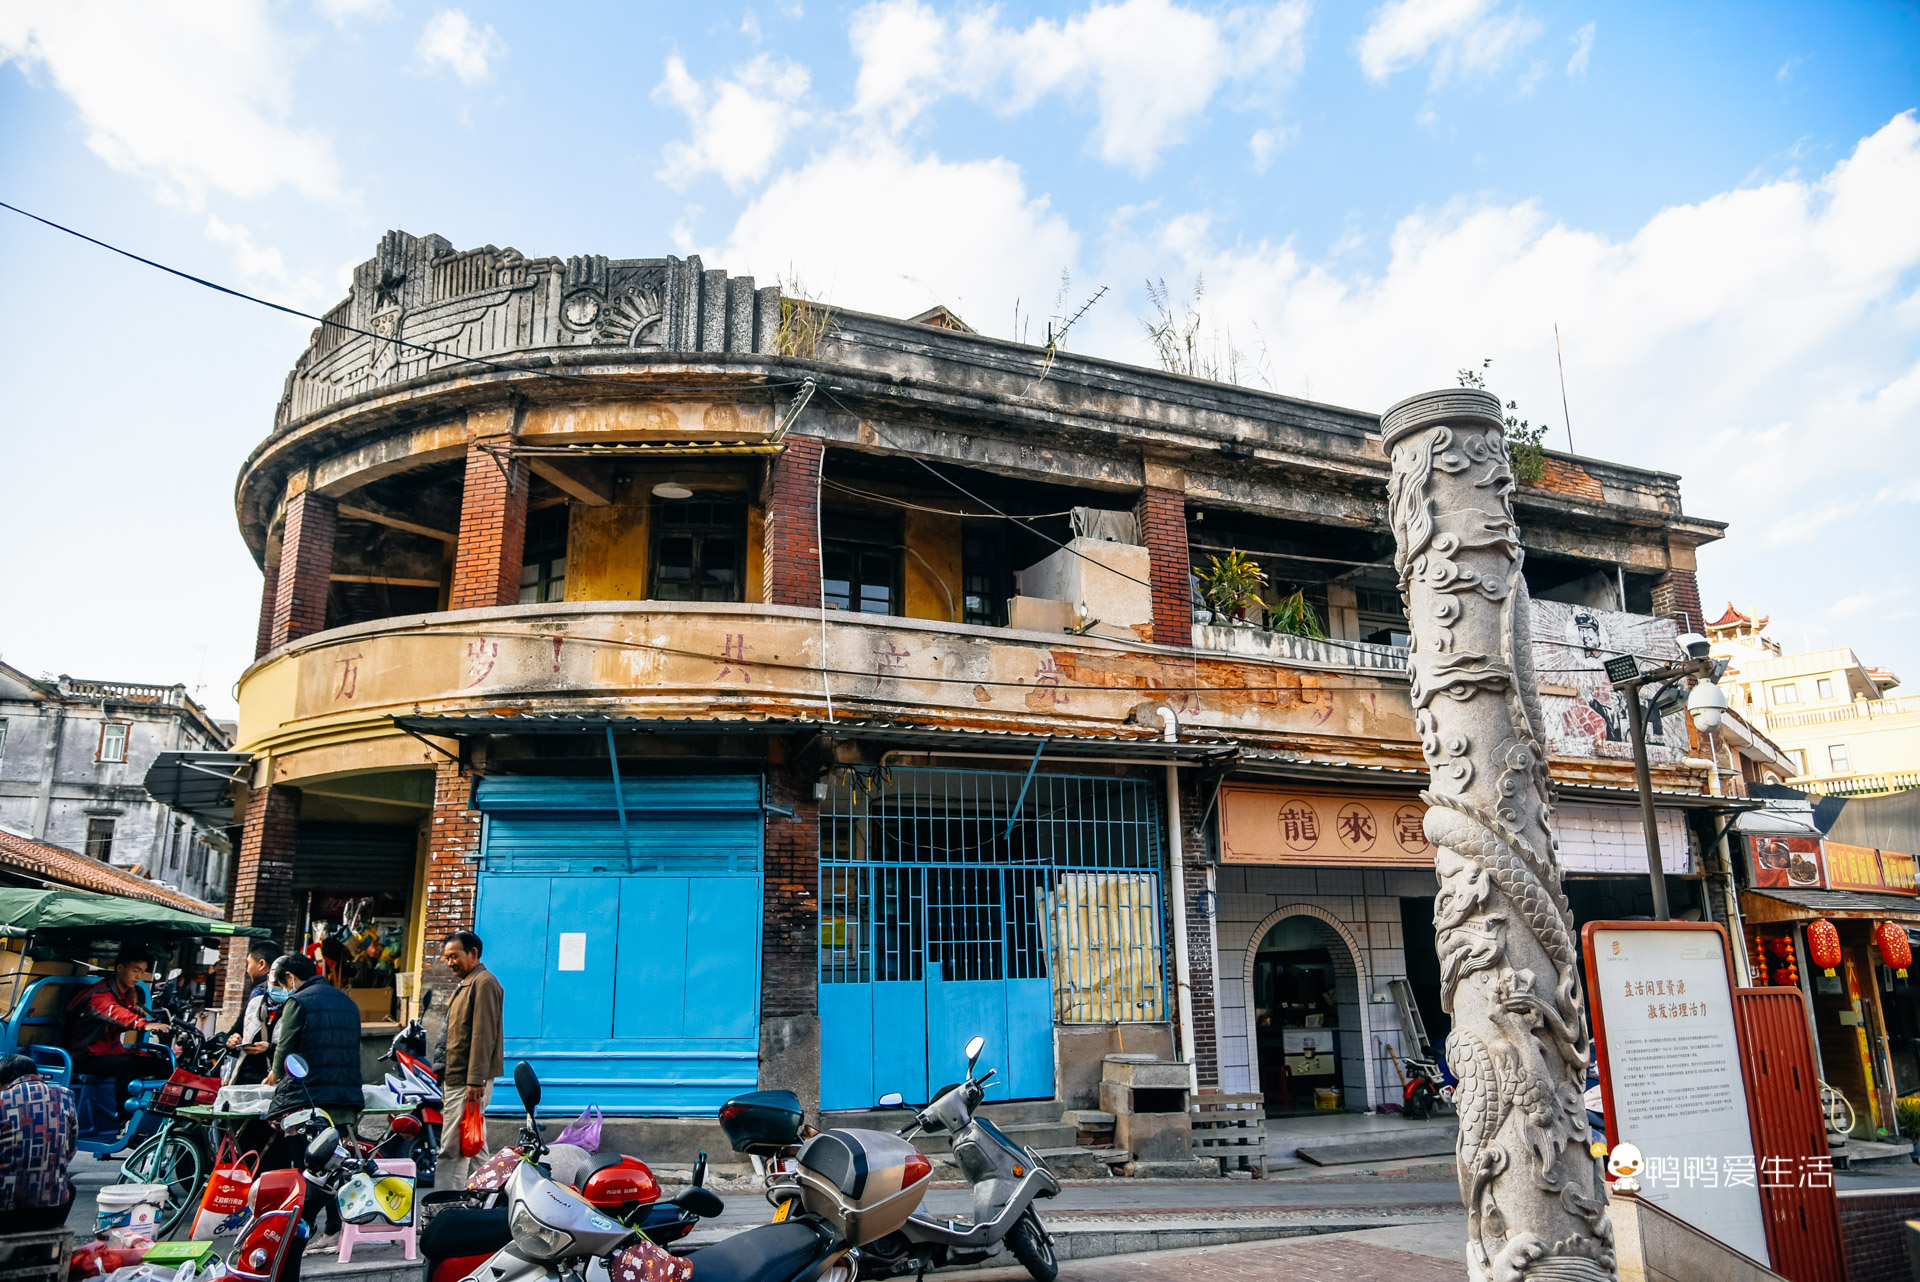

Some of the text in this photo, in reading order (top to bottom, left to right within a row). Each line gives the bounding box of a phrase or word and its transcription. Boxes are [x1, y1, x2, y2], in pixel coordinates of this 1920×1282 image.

[1624, 979, 1686, 997] 盘活闲置资源
[1647, 1001, 1707, 1019] 激发治理活力
